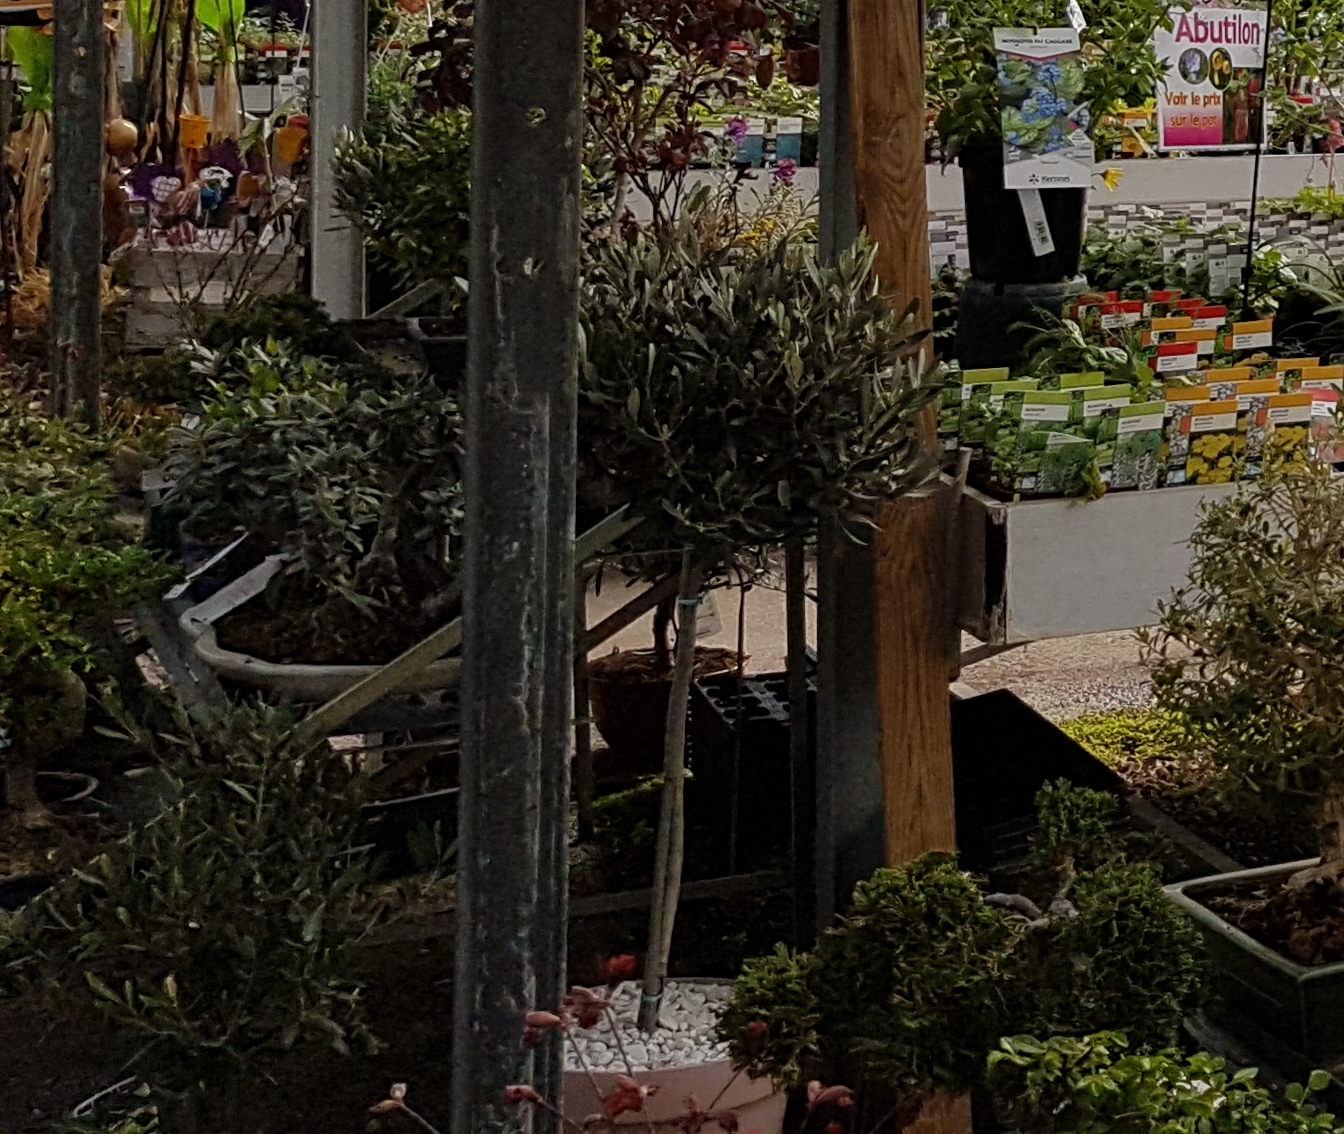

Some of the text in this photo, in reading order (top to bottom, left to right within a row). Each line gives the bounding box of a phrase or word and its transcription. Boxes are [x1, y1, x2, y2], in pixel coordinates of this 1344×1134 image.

[1175, 11, 1260, 45] Abutilon
[1165, 92, 1221, 107] Voir le prix
[1170, 113, 1217, 130] sur le pot
